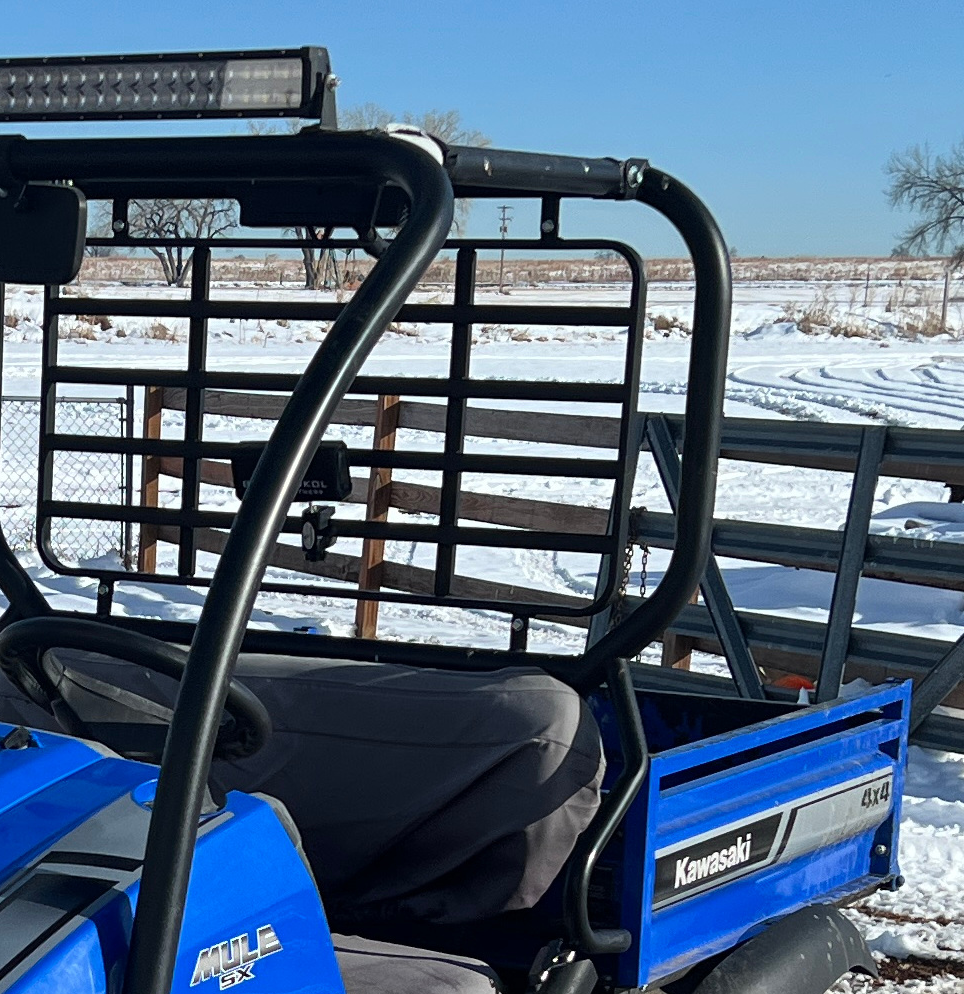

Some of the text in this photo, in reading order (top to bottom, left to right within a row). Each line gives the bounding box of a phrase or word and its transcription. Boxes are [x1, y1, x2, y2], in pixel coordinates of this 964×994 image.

[861, 781, 890, 808] 4x4
[674, 833, 752, 889] Kawasaki
[190, 924, 284, 987] MULE
[219, 962, 256, 991] SX
